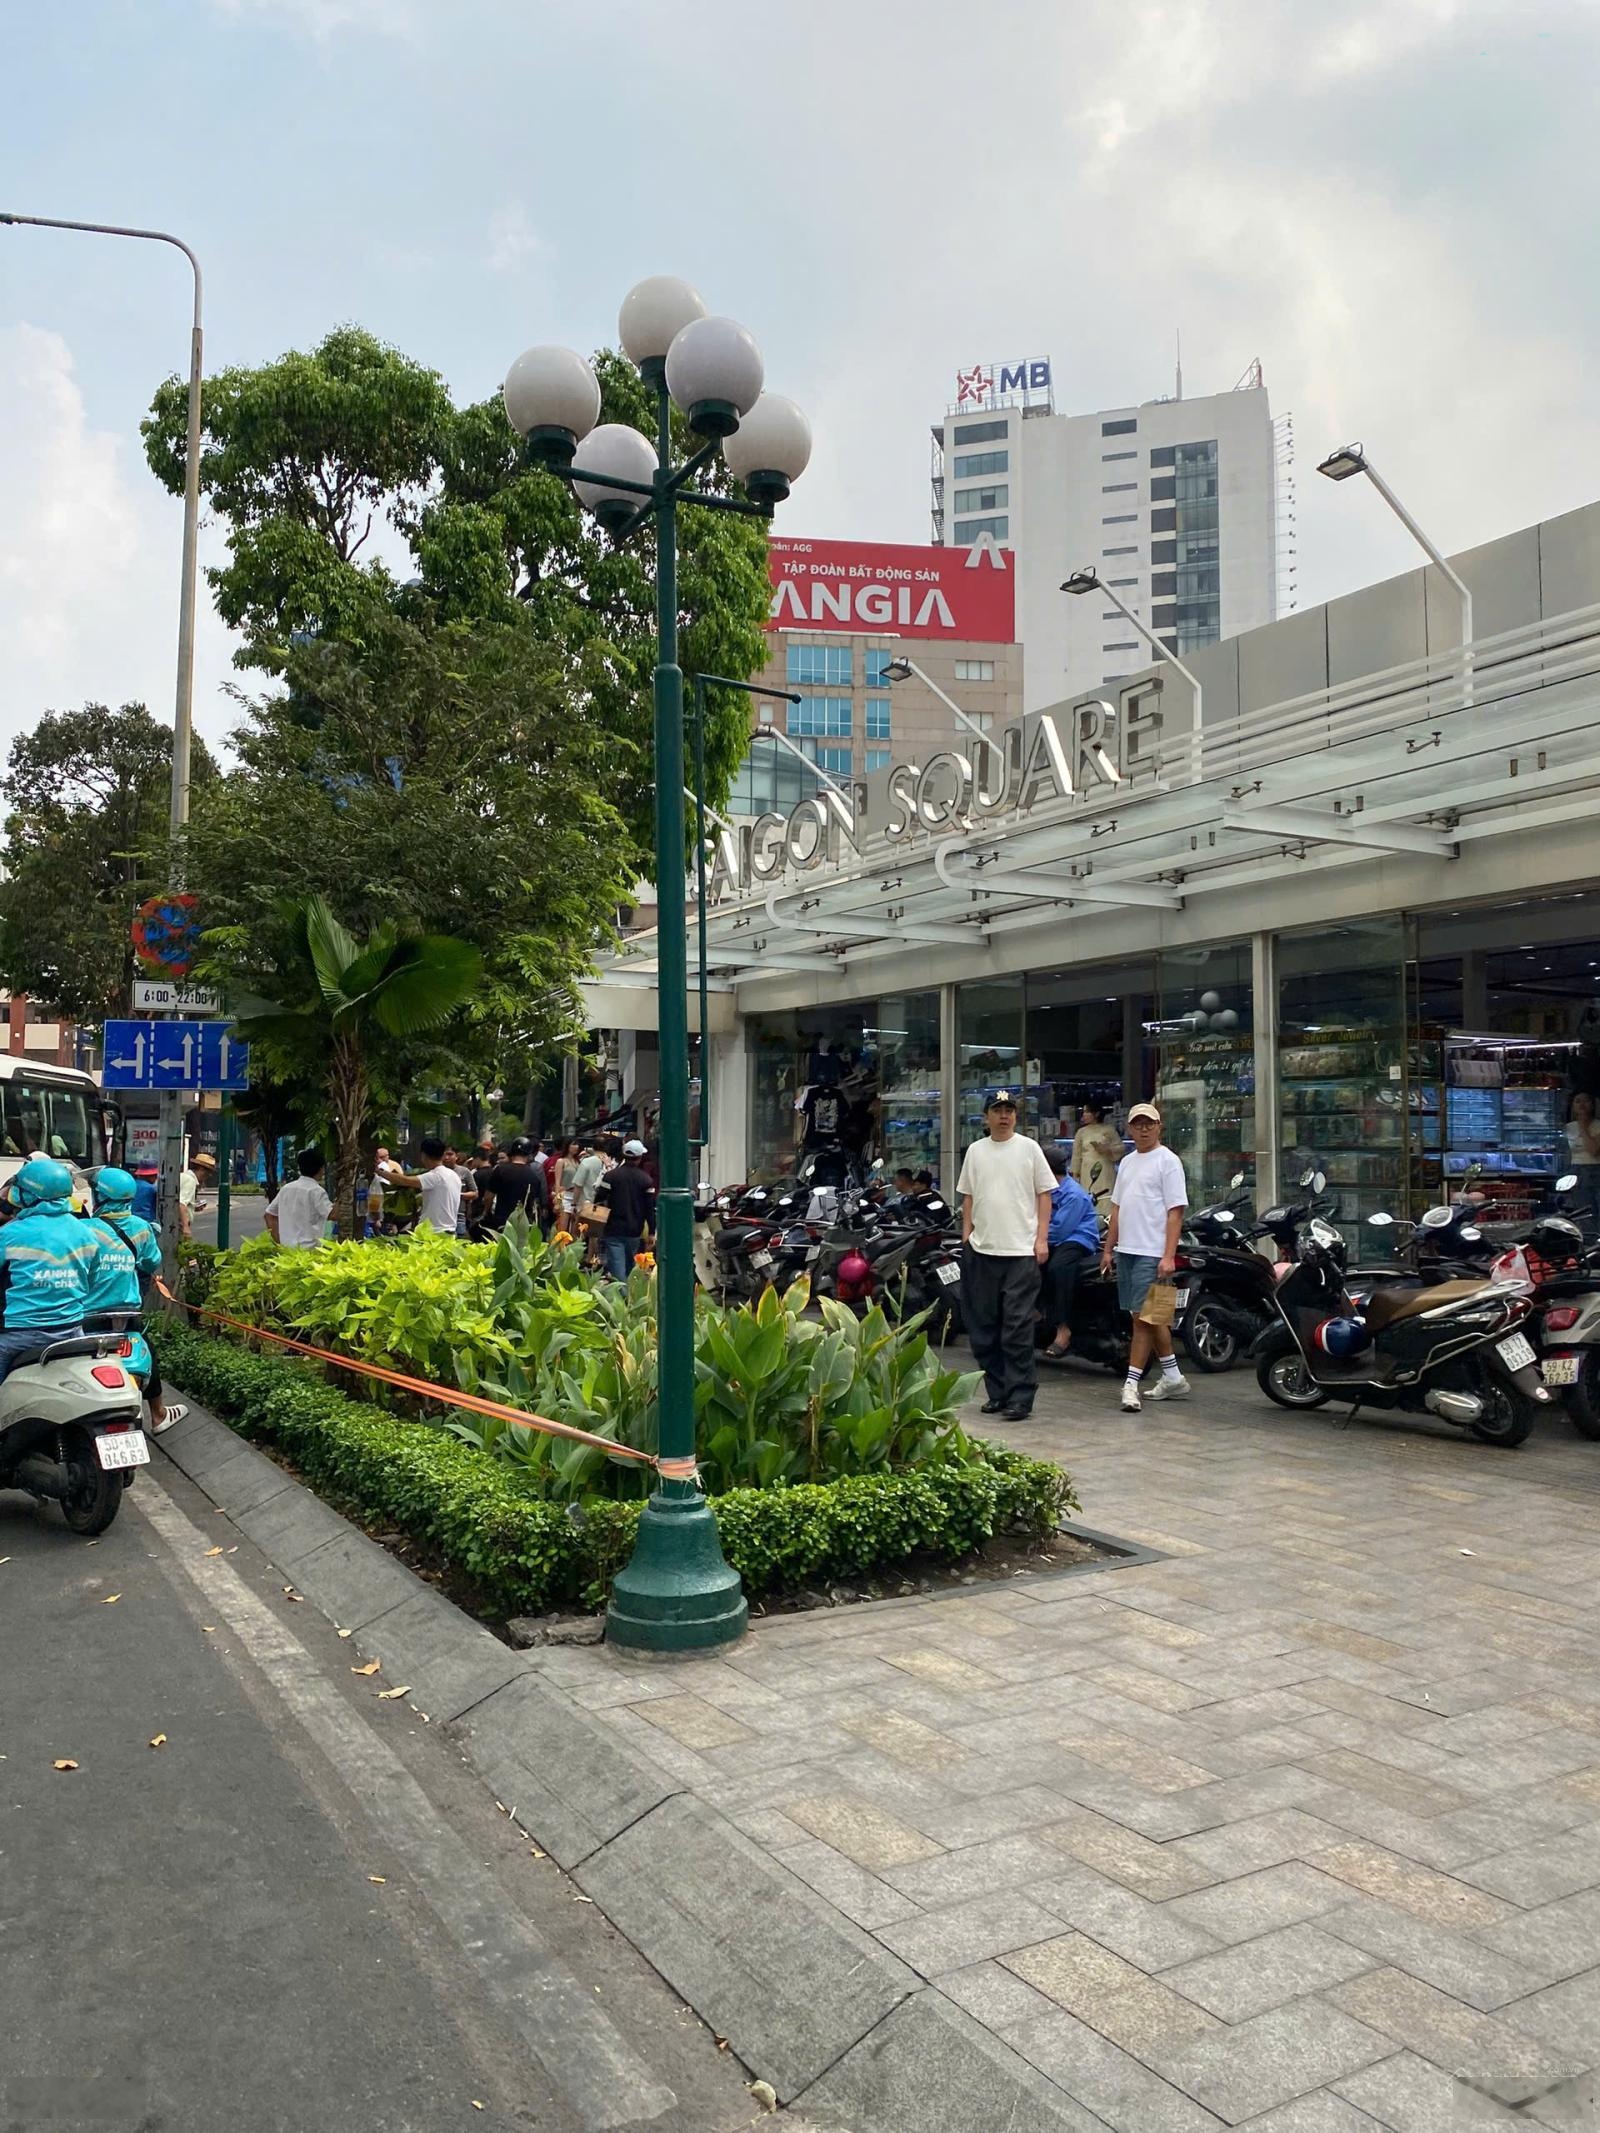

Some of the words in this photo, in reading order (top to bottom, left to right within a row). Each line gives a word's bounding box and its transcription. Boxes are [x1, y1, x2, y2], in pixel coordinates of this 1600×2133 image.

[1000, 362, 1050, 394] MB
[792, 543, 813, 553] AGG
[782, 560, 807, 576] TẬP
[810, 561, 846, 577] ĐOÀN
[849, 562, 873, 578] BẤT
[876, 564, 912, 582] ĐỘNG
[915, 567, 940, 582] SẢN
[771, 580, 957, 628] ANGIA
[884, 677, 1163, 843] SQUARE
[132, 1130, 158, 1140] 300
[100, 1253, 126, 1263] ANH
